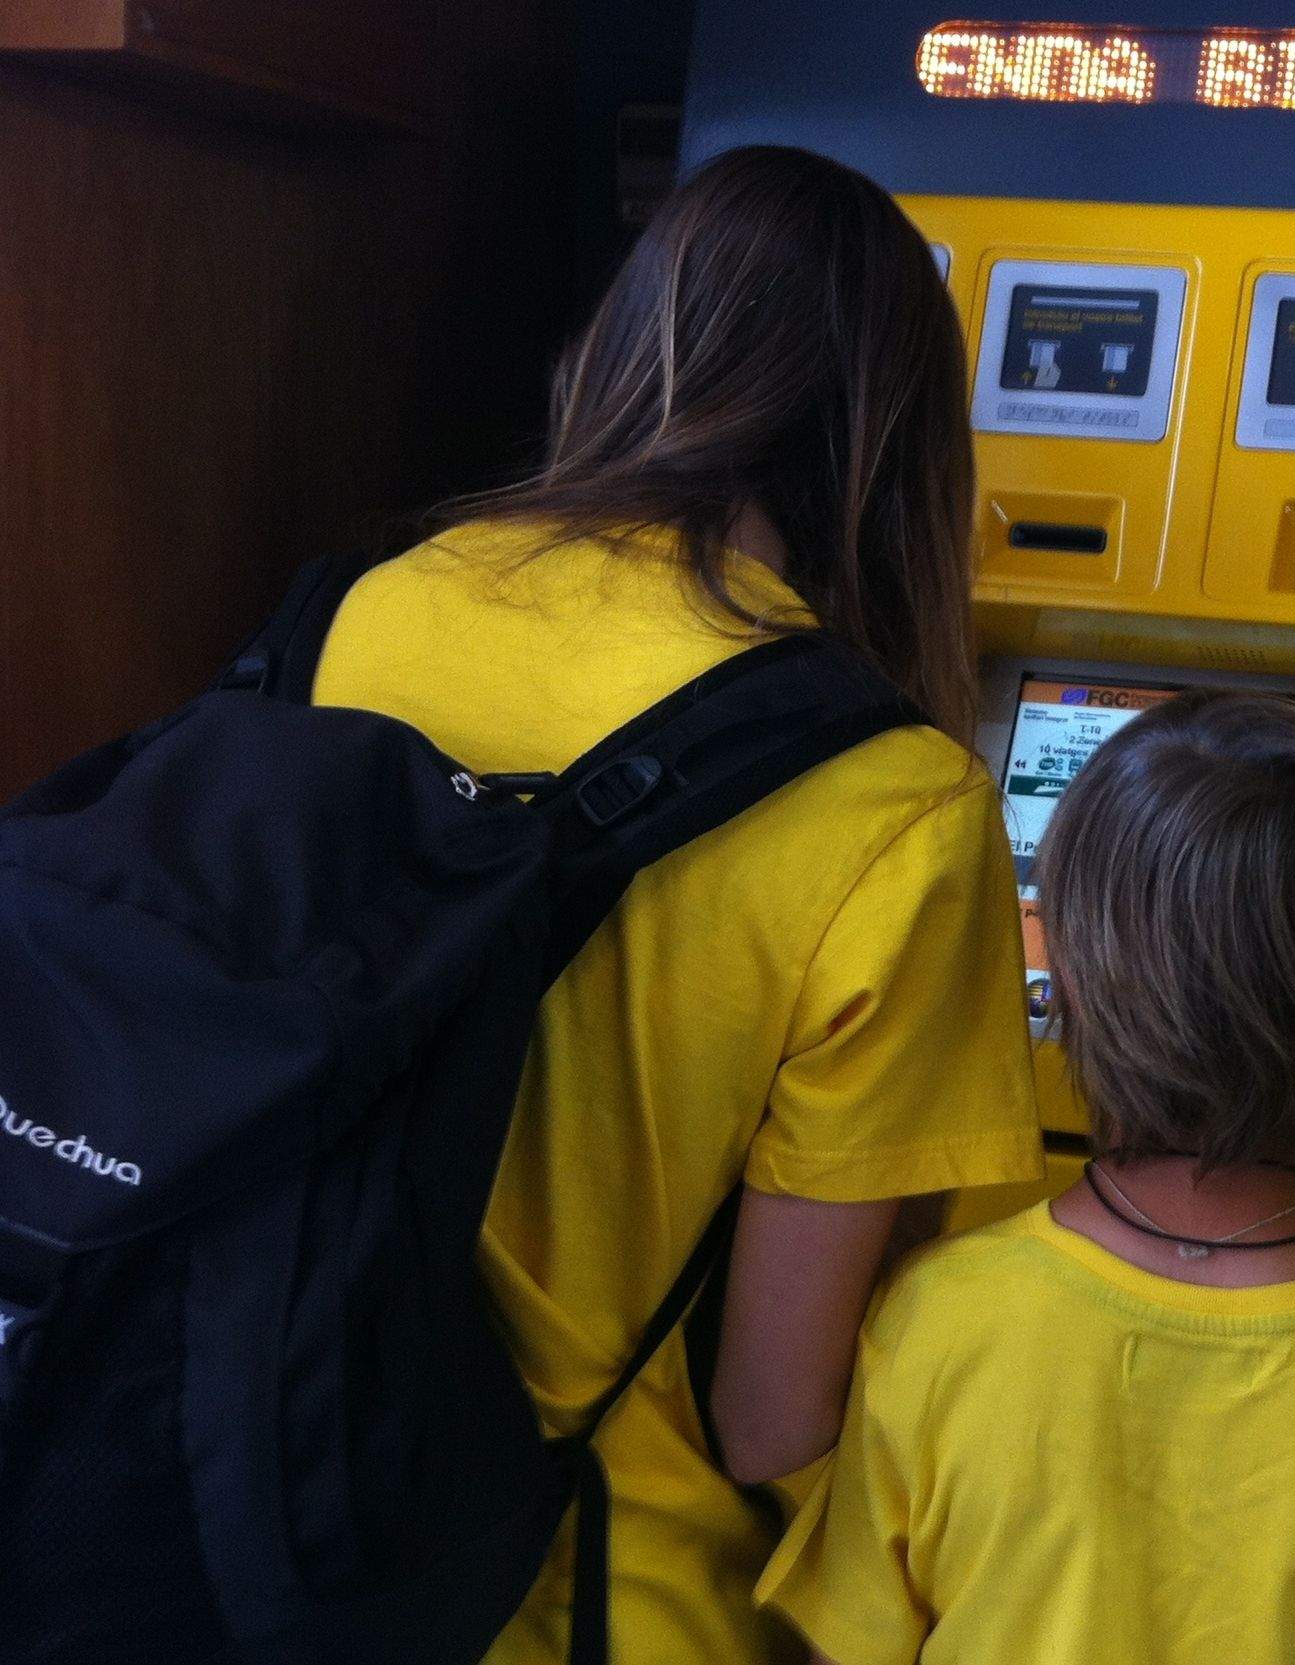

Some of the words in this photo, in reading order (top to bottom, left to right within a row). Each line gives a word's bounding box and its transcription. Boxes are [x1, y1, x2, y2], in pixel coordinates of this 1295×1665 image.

[1086, 690, 1130, 707] FGC
[1039, 744, 1051, 754] 10
[0, 1096, 143, 1186] uechua
